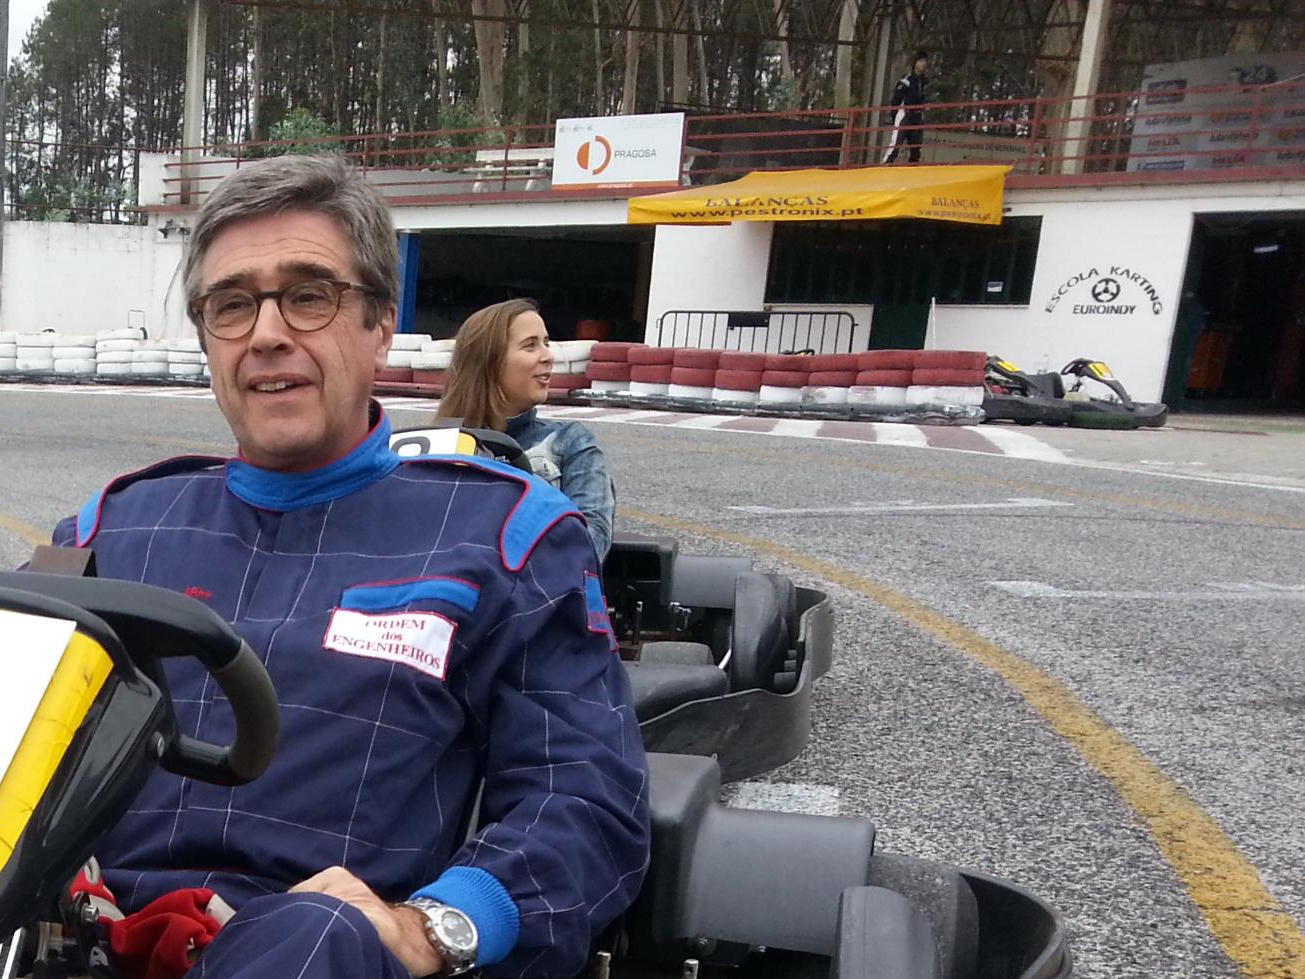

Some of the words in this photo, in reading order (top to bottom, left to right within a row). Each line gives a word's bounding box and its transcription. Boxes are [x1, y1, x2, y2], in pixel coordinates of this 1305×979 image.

[614, 149, 657, 159] PRAGOSA
[671, 206, 864, 218] www.pestronix.pt
[1045, 268, 1100, 314] ESCOLA
[1110, 266, 1163, 316] KARTING
[1072, 304, 1137, 315] EUROINDY
[365, 618, 426, 631] ORDEM
[381, 631, 404, 642] dos
[331, 633, 441, 670] ENGENHEIROS
